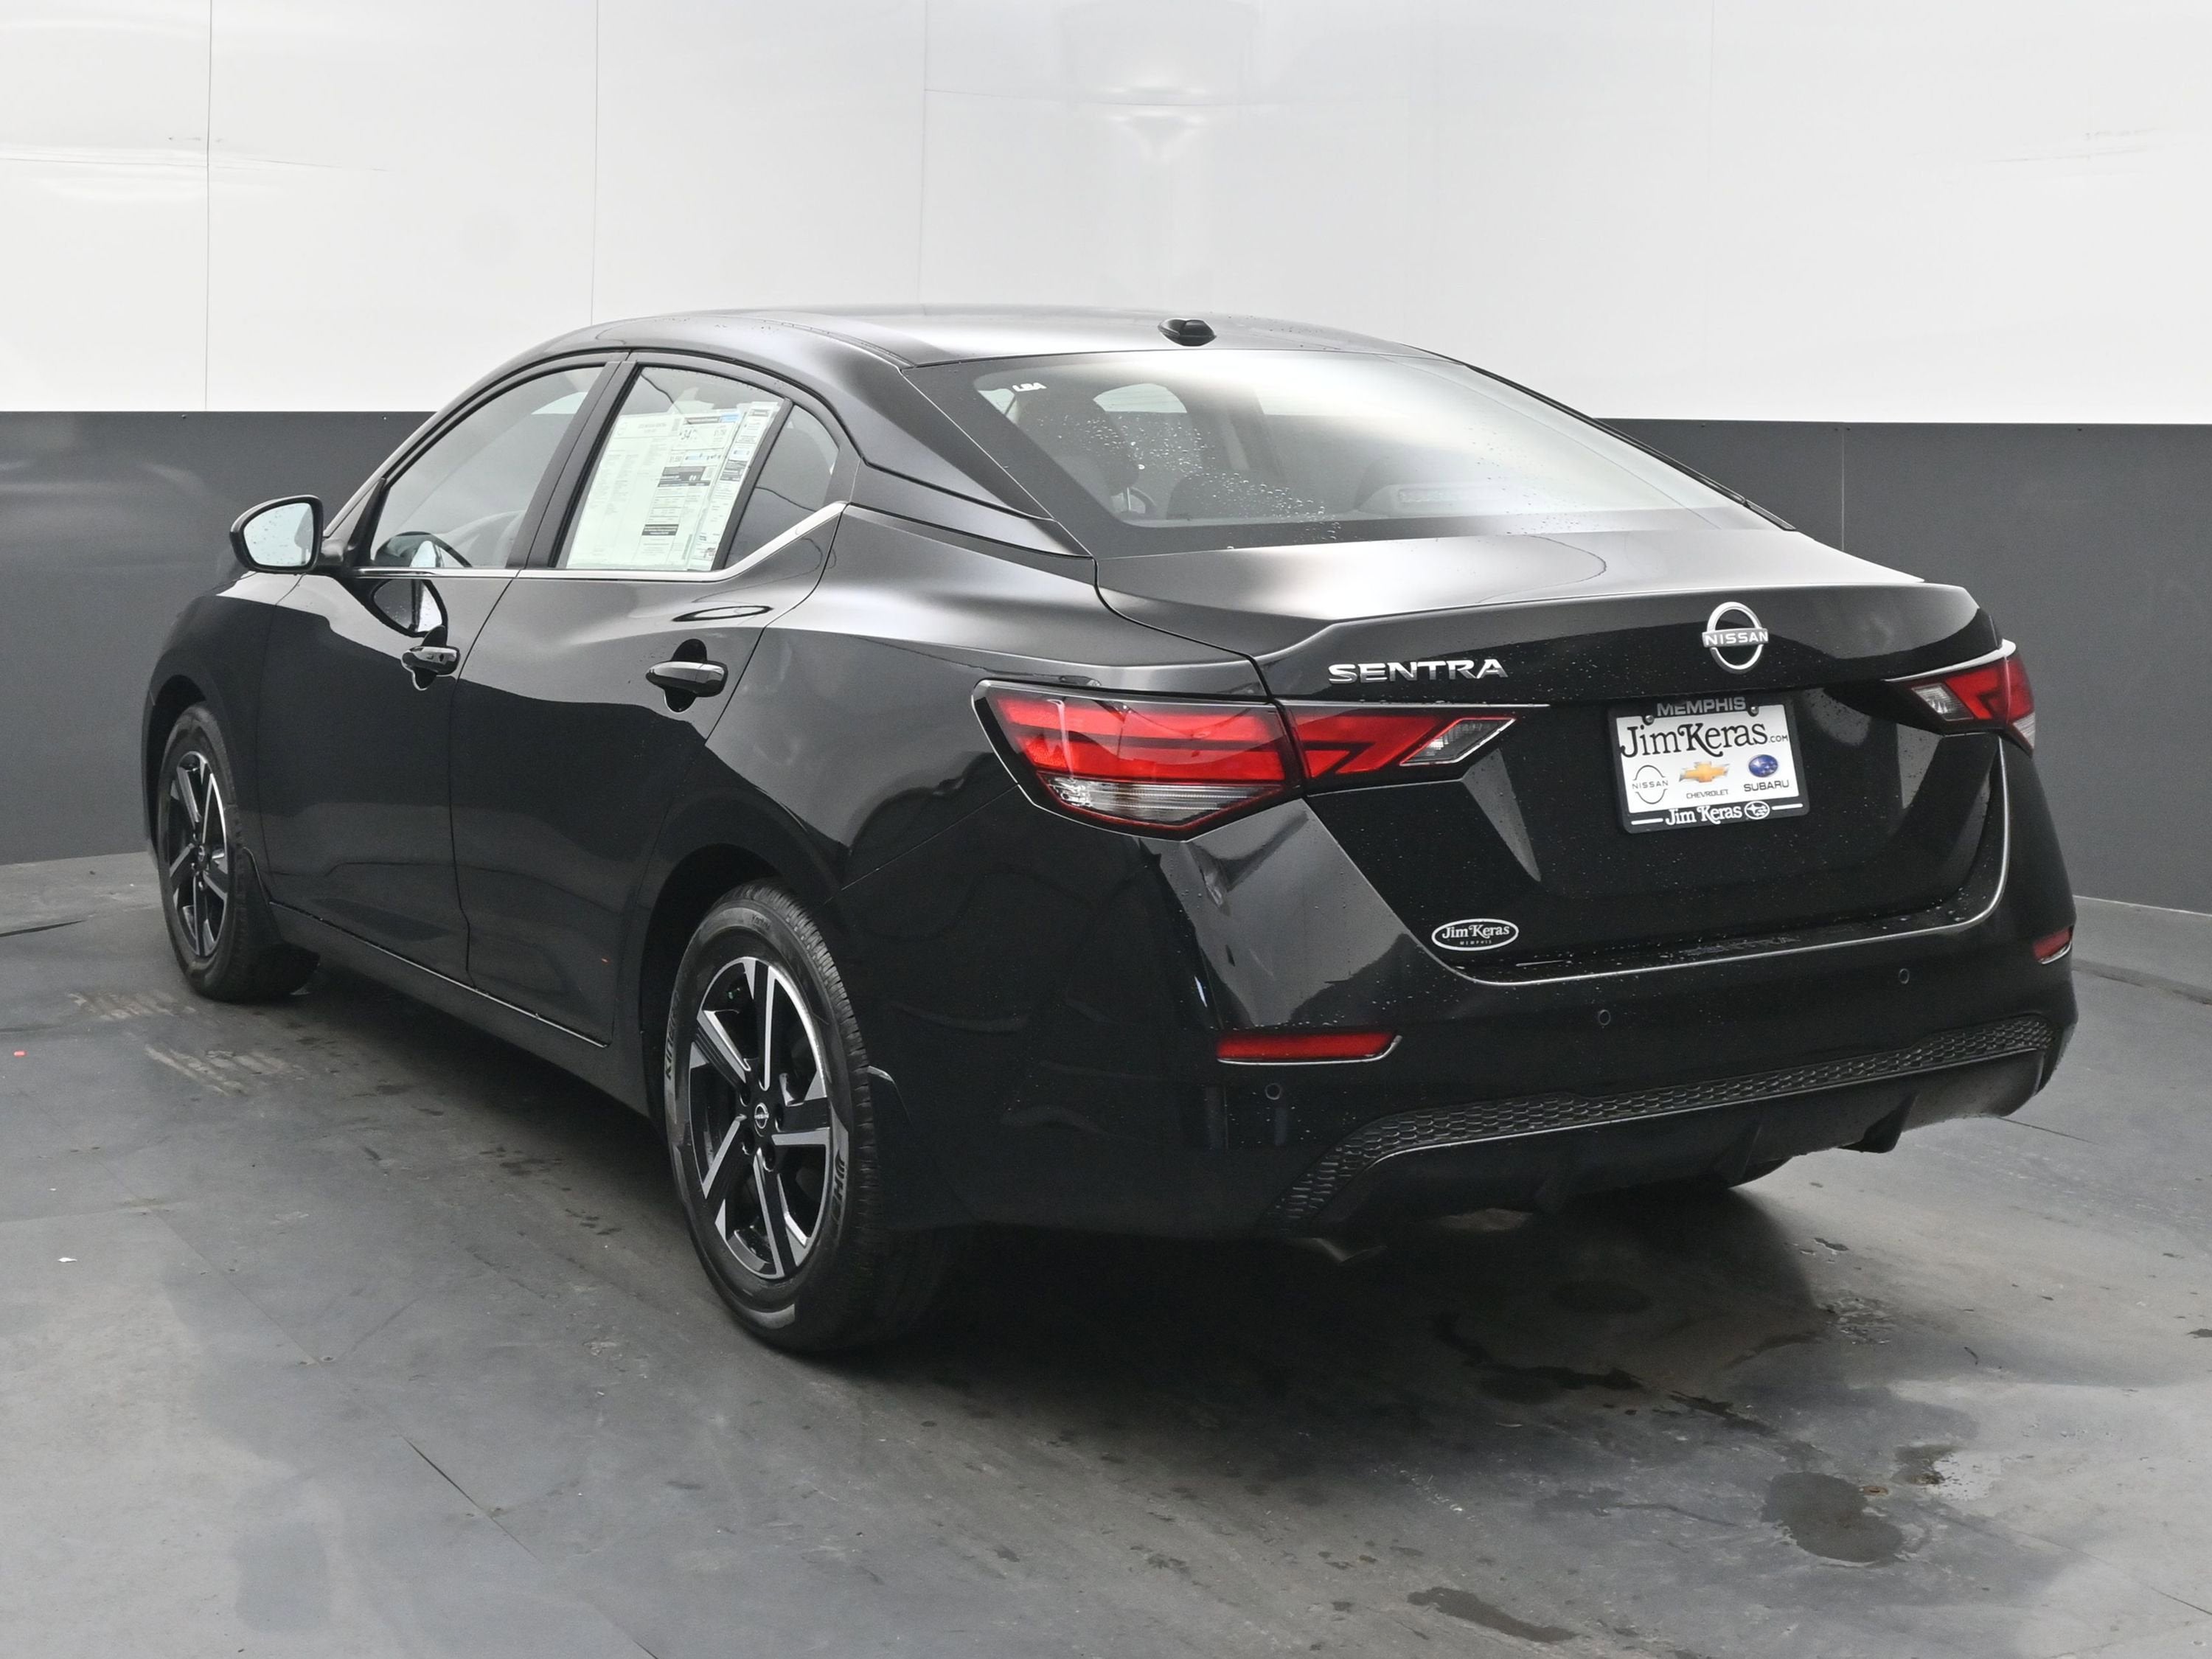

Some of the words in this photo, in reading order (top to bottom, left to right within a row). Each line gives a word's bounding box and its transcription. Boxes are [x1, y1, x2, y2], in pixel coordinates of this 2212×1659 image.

[1705, 631, 1769, 646] NISSAN
[1328, 658, 1509, 684] SENTRA
[1657, 697, 1747, 717] MEMPHIS
[1632, 779, 1669, 789] NISSAN
[1744, 779, 1790, 792] SUBARU
[1686, 789, 1729, 799] CHEVROLET
[1665, 809, 1697, 826] Jim
[1697, 805, 1743, 825] Keras
[1469, 924, 1510, 939] Keras
